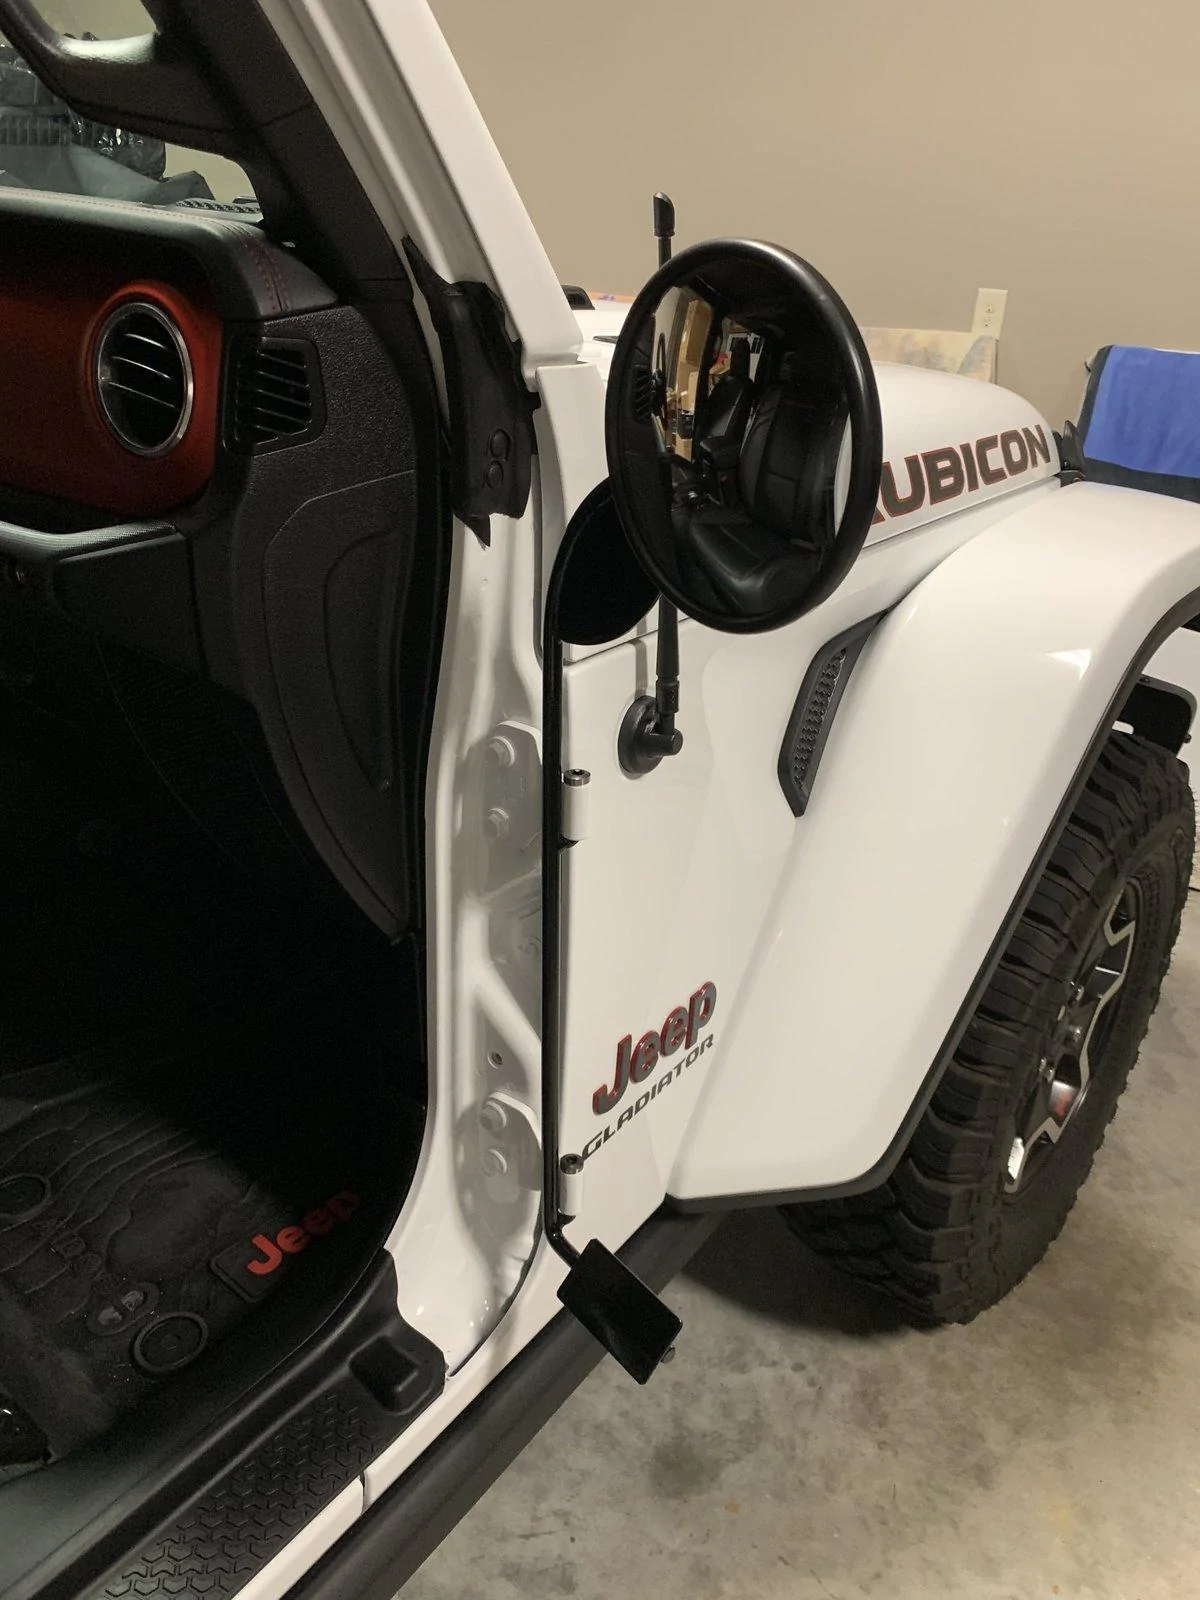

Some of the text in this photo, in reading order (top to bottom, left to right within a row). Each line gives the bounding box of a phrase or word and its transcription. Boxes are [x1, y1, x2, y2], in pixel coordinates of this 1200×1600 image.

[872, 424, 1051, 525] UBICON
[582, 1033, 714, 1161] GLADIATOR
[592, 981, 717, 1116] Jeep
[246, 1190, 360, 1276] Jeep
